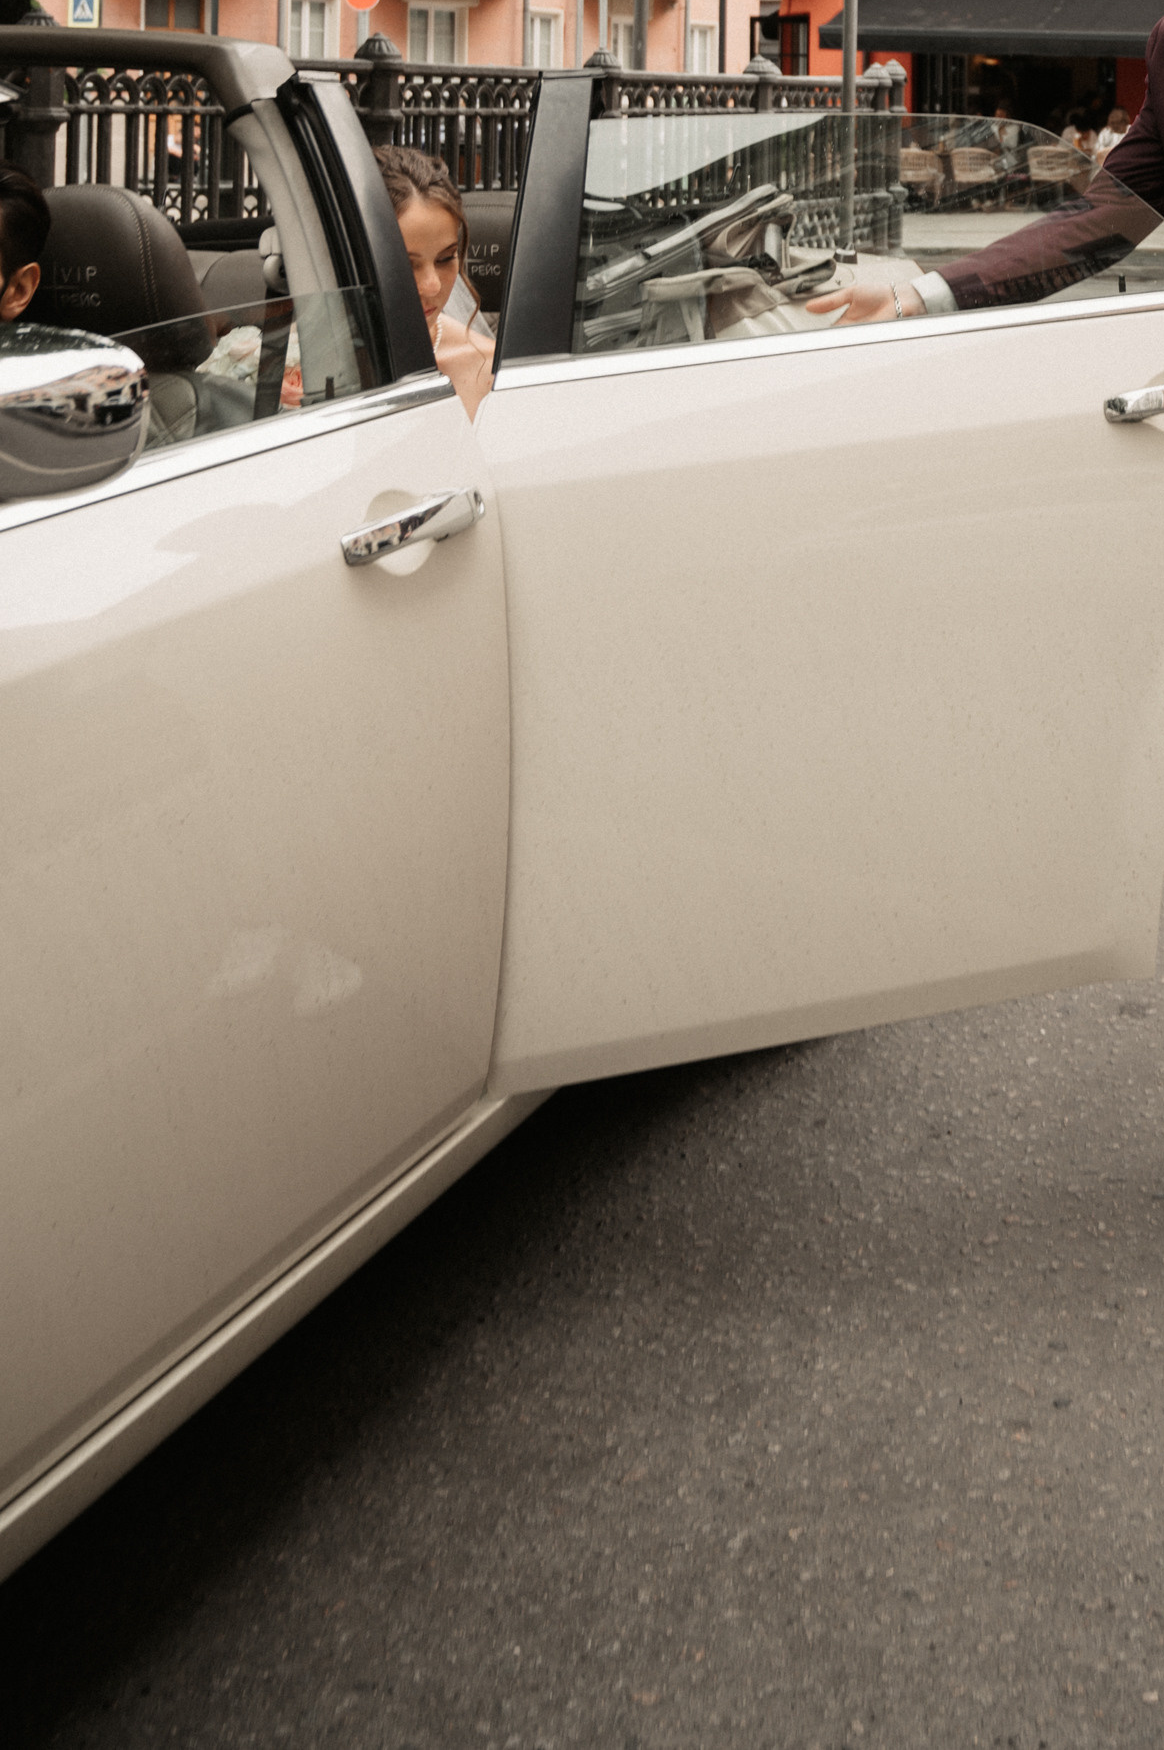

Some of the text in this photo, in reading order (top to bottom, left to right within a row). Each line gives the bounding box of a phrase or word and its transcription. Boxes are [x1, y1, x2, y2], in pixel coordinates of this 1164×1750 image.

[471, 243, 499, 257] VIP
[60, 265, 97, 283] VIP
[471, 263, 501, 276] РЕЙС
